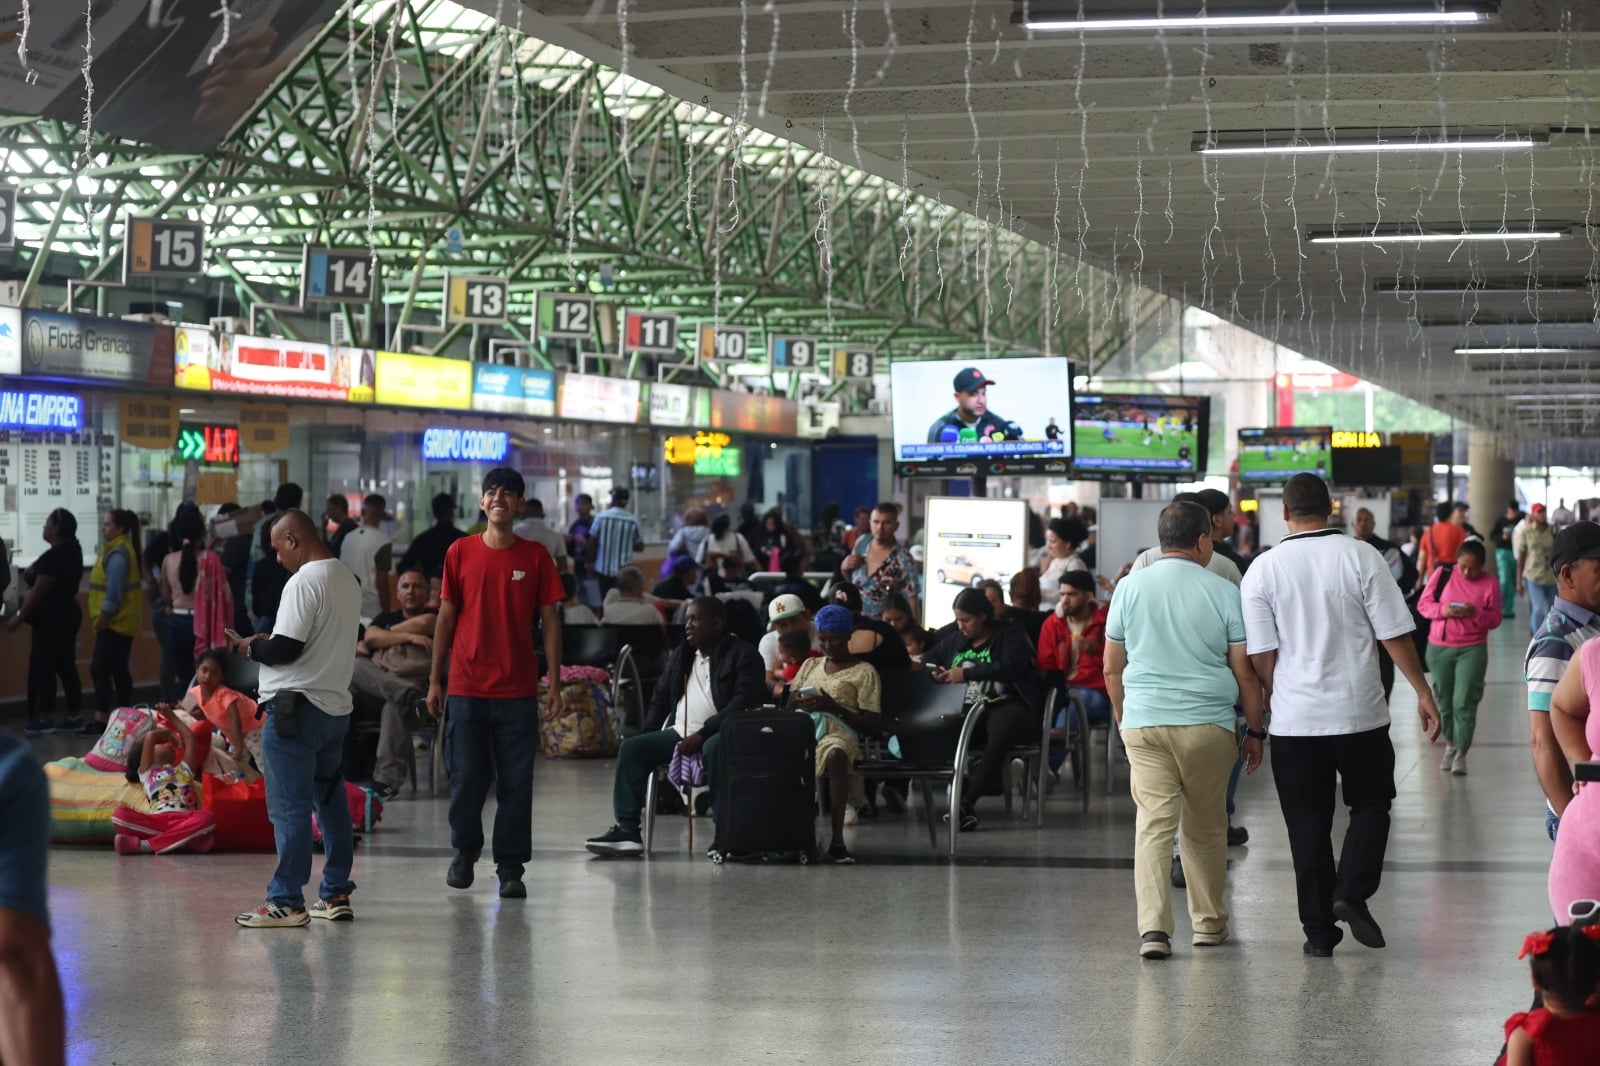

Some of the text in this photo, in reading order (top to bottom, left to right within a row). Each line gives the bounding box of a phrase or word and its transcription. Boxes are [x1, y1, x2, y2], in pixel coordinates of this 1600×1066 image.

[155, 229, 196, 267] 15
[330, 260, 367, 294] 14
[469, 284, 503, 316] 13
[556, 302, 588, 331] 12
[48, 326, 140, 355] Flota Granada
[642, 319, 669, 346] 11
[716, 332, 744, 358] 10
[791, 341, 810, 366] 9
[852, 353, 869, 376] 8
[424, 428, 461, 459] GRUPO
[917, 446, 944, 454] ECUADOR
